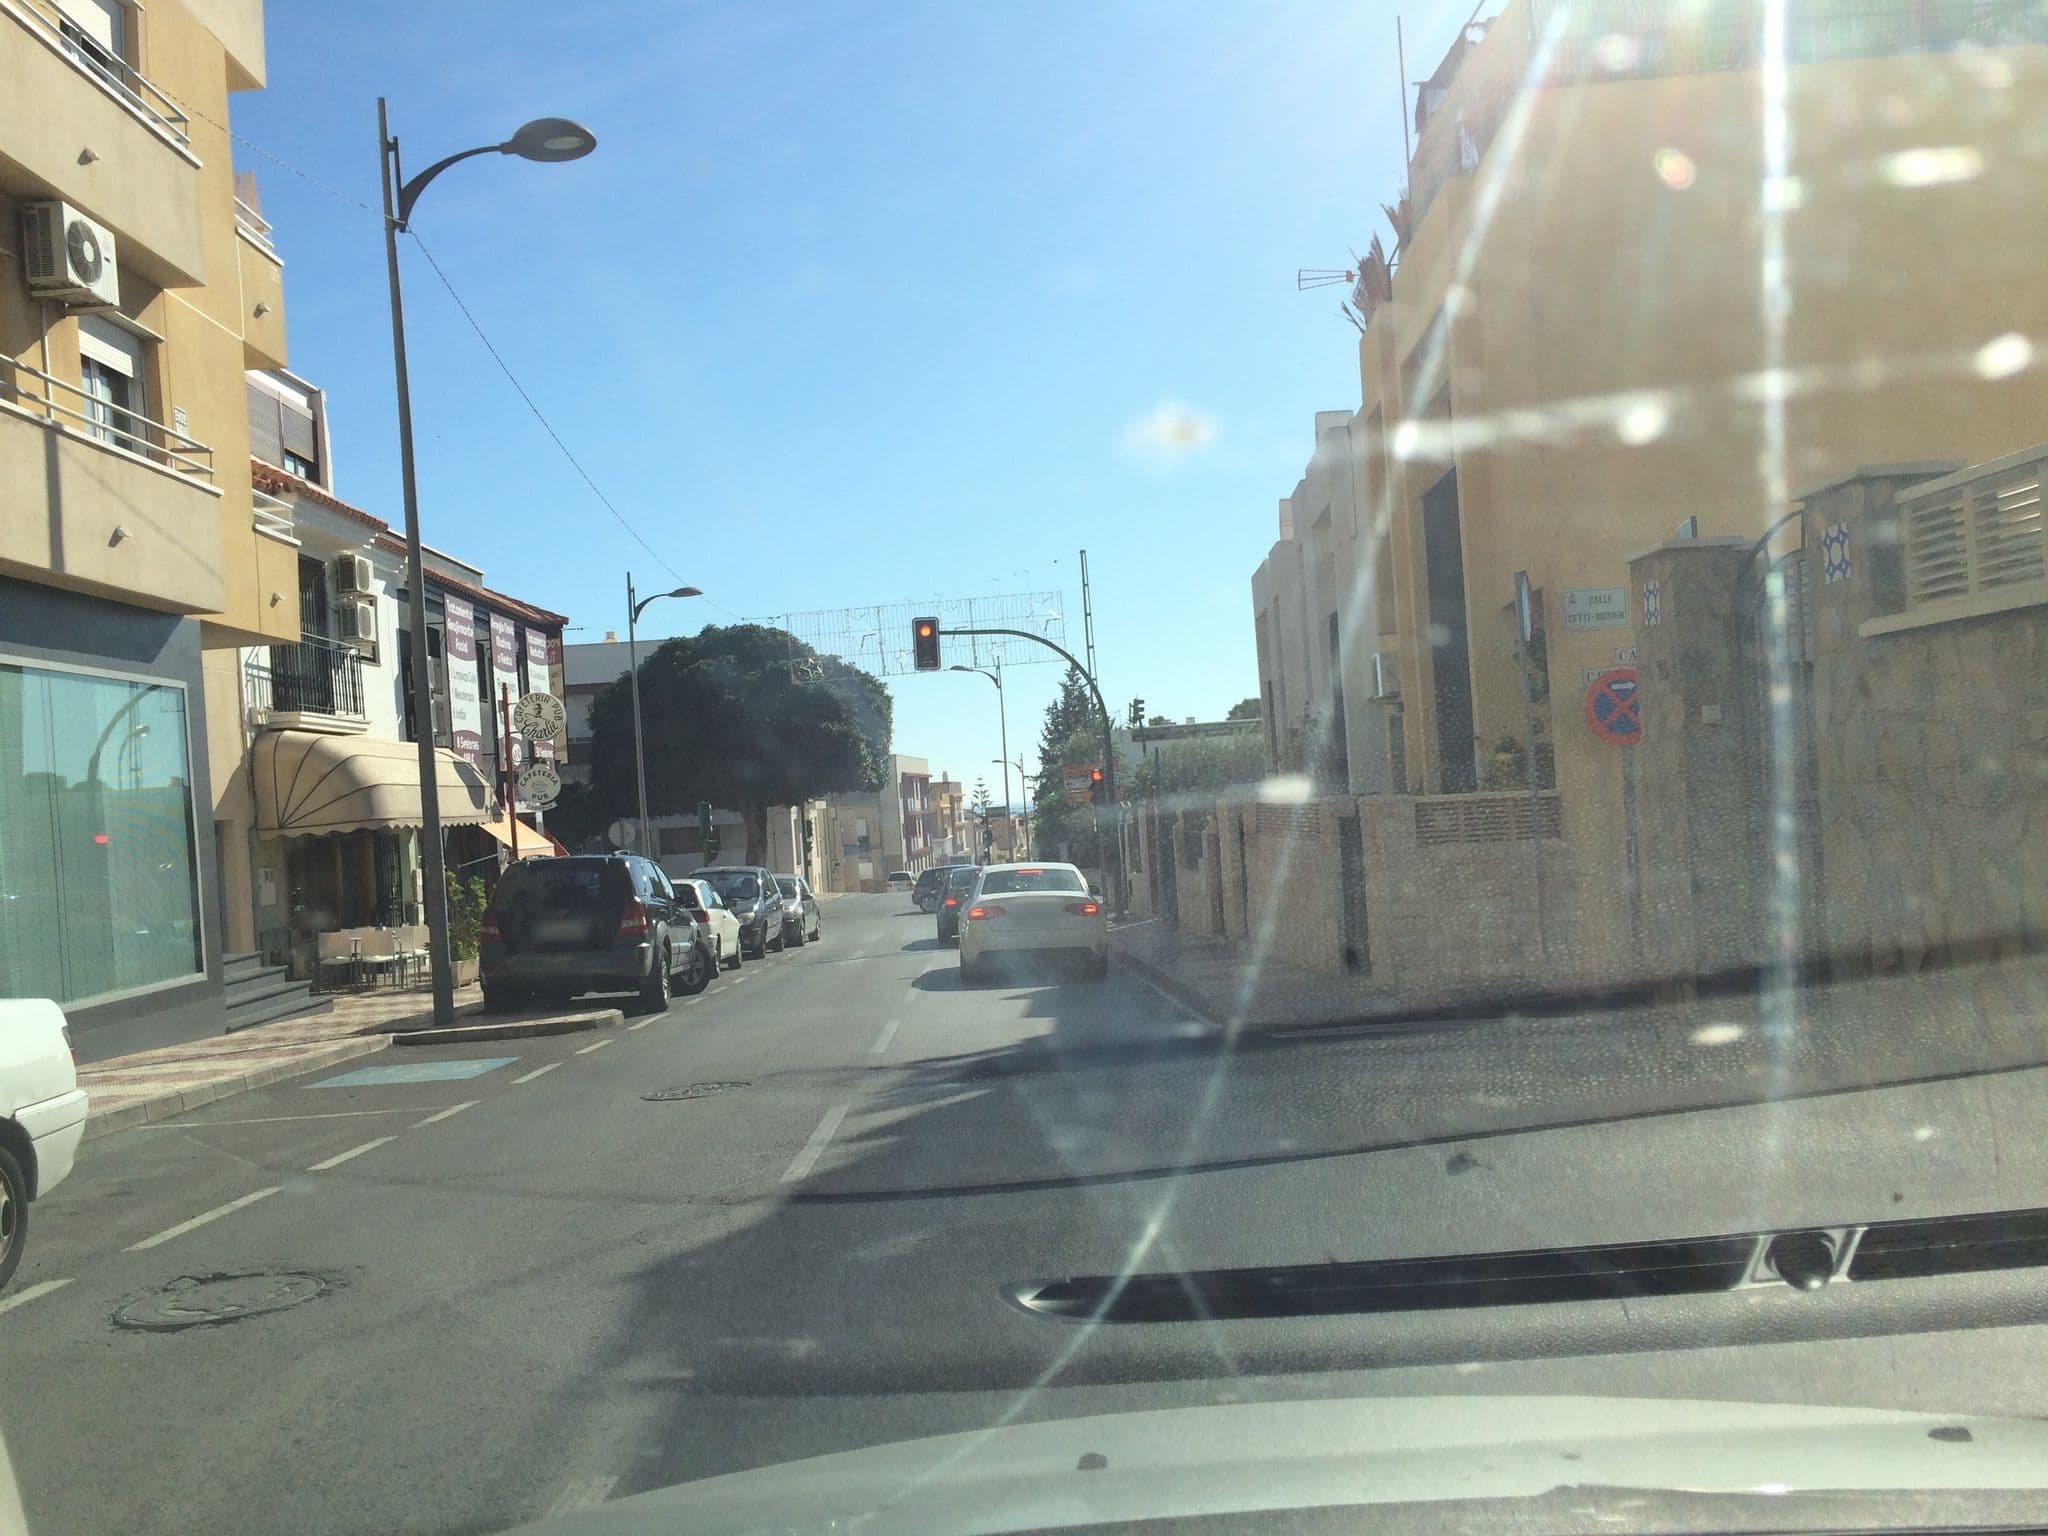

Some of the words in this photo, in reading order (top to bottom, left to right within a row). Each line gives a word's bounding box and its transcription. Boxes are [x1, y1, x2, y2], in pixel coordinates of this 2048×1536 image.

[1588, 594, 1612, 605] CALLE
[515, 694, 550, 723] CAFETERIA
[550, 703, 563, 721] PUB
[521, 718, 559, 739] Charlie
[519, 769, 558, 787] CAFETERIA
[532, 793, 550, 802] PUB
